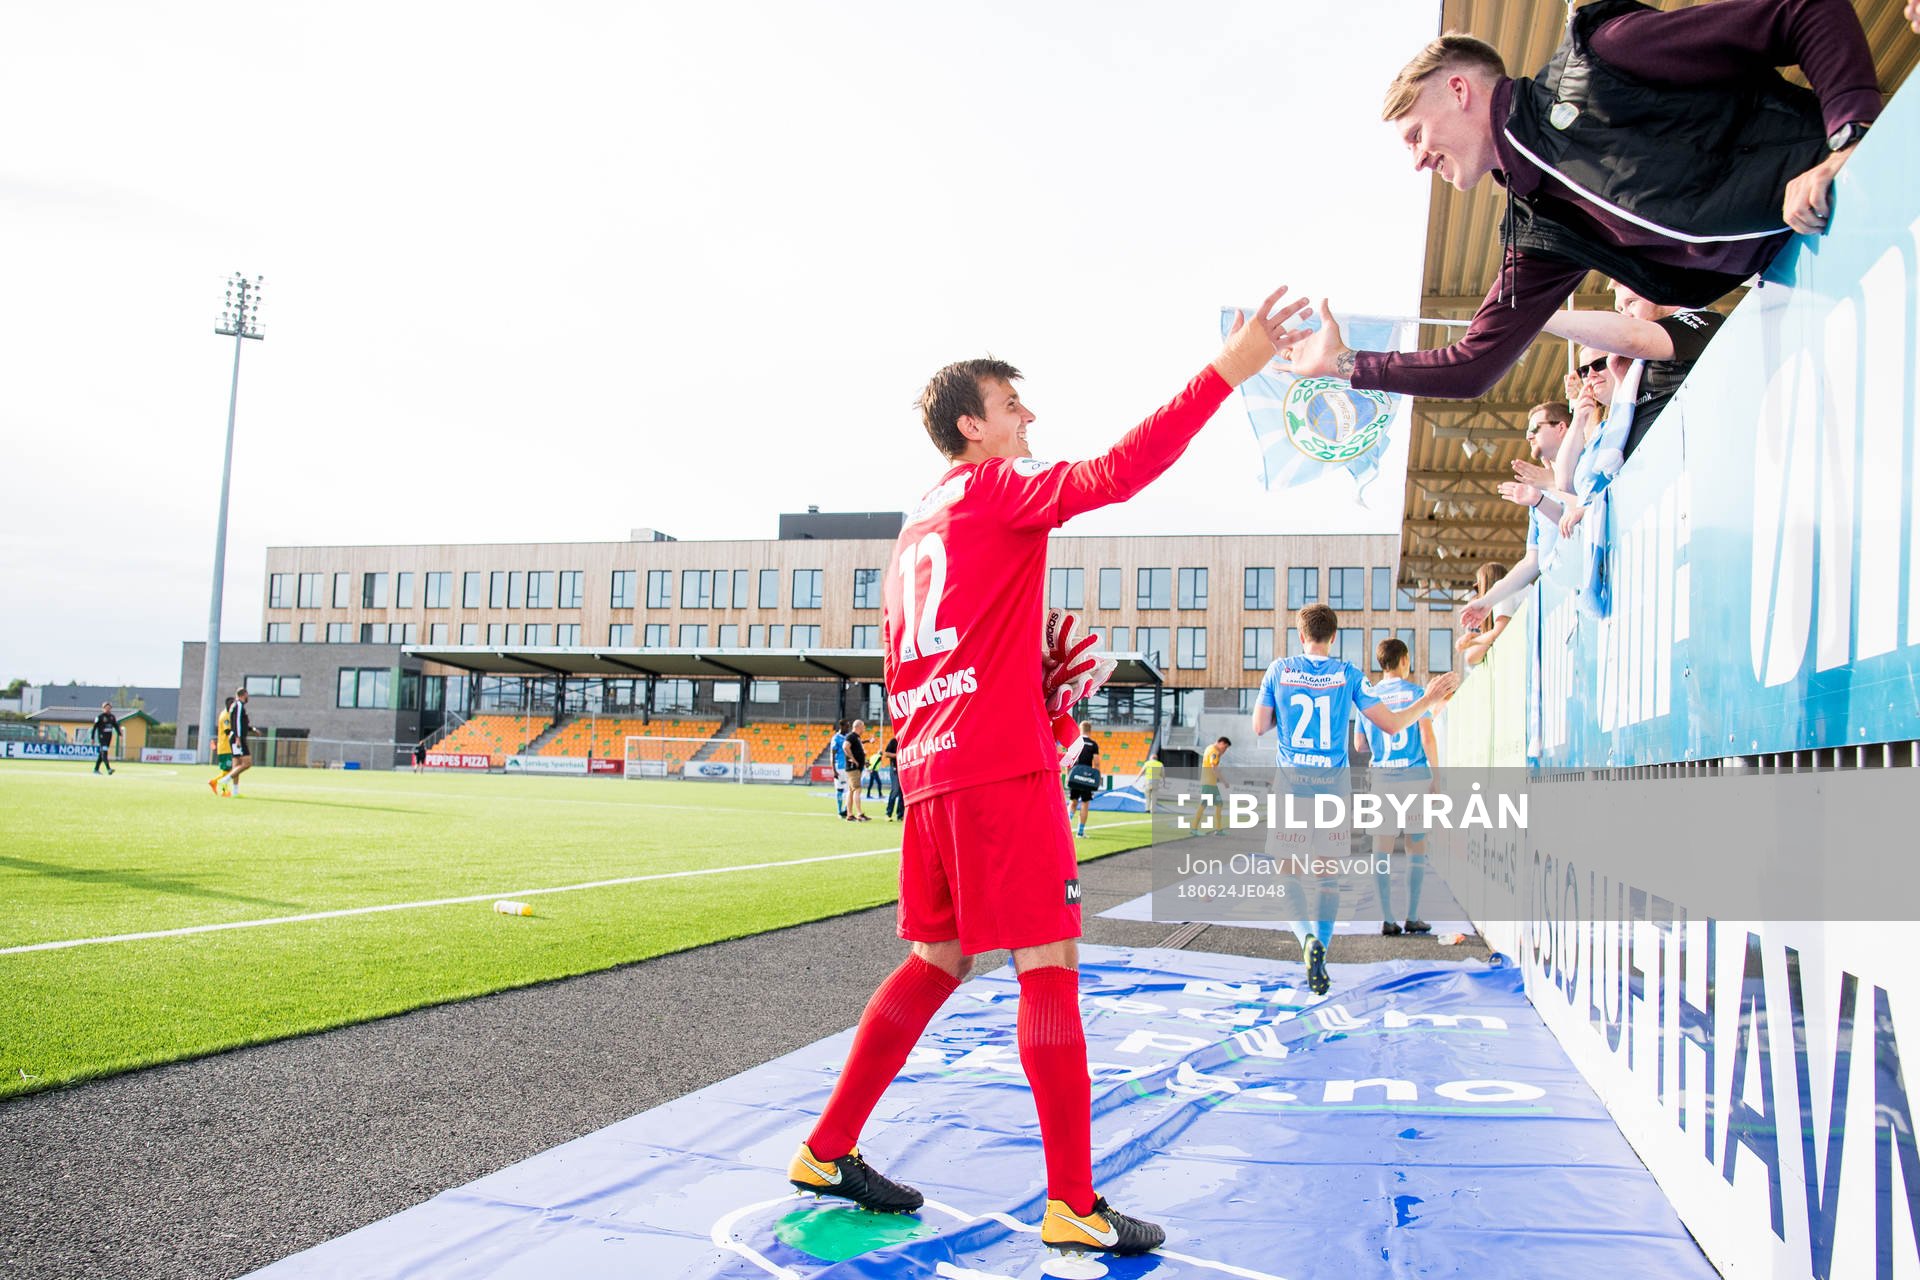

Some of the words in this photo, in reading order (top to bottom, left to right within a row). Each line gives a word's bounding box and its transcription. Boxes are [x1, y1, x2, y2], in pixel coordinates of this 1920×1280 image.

[898, 532, 960, 663] 12
[1290, 693, 1331, 750] 21
[26, 743, 47, 753] AAS
[920, 731, 957, 757] VALG!
[425, 754, 460, 767] PEPPES
[462, 755, 489, 768] PIZZA
[702, 765, 726, 776] Ford
[1275, 831, 1306, 843] auto
[1530, 848, 1579, 1006] OSLO
[1589, 870, 1920, 1280] LUFTHAVN
